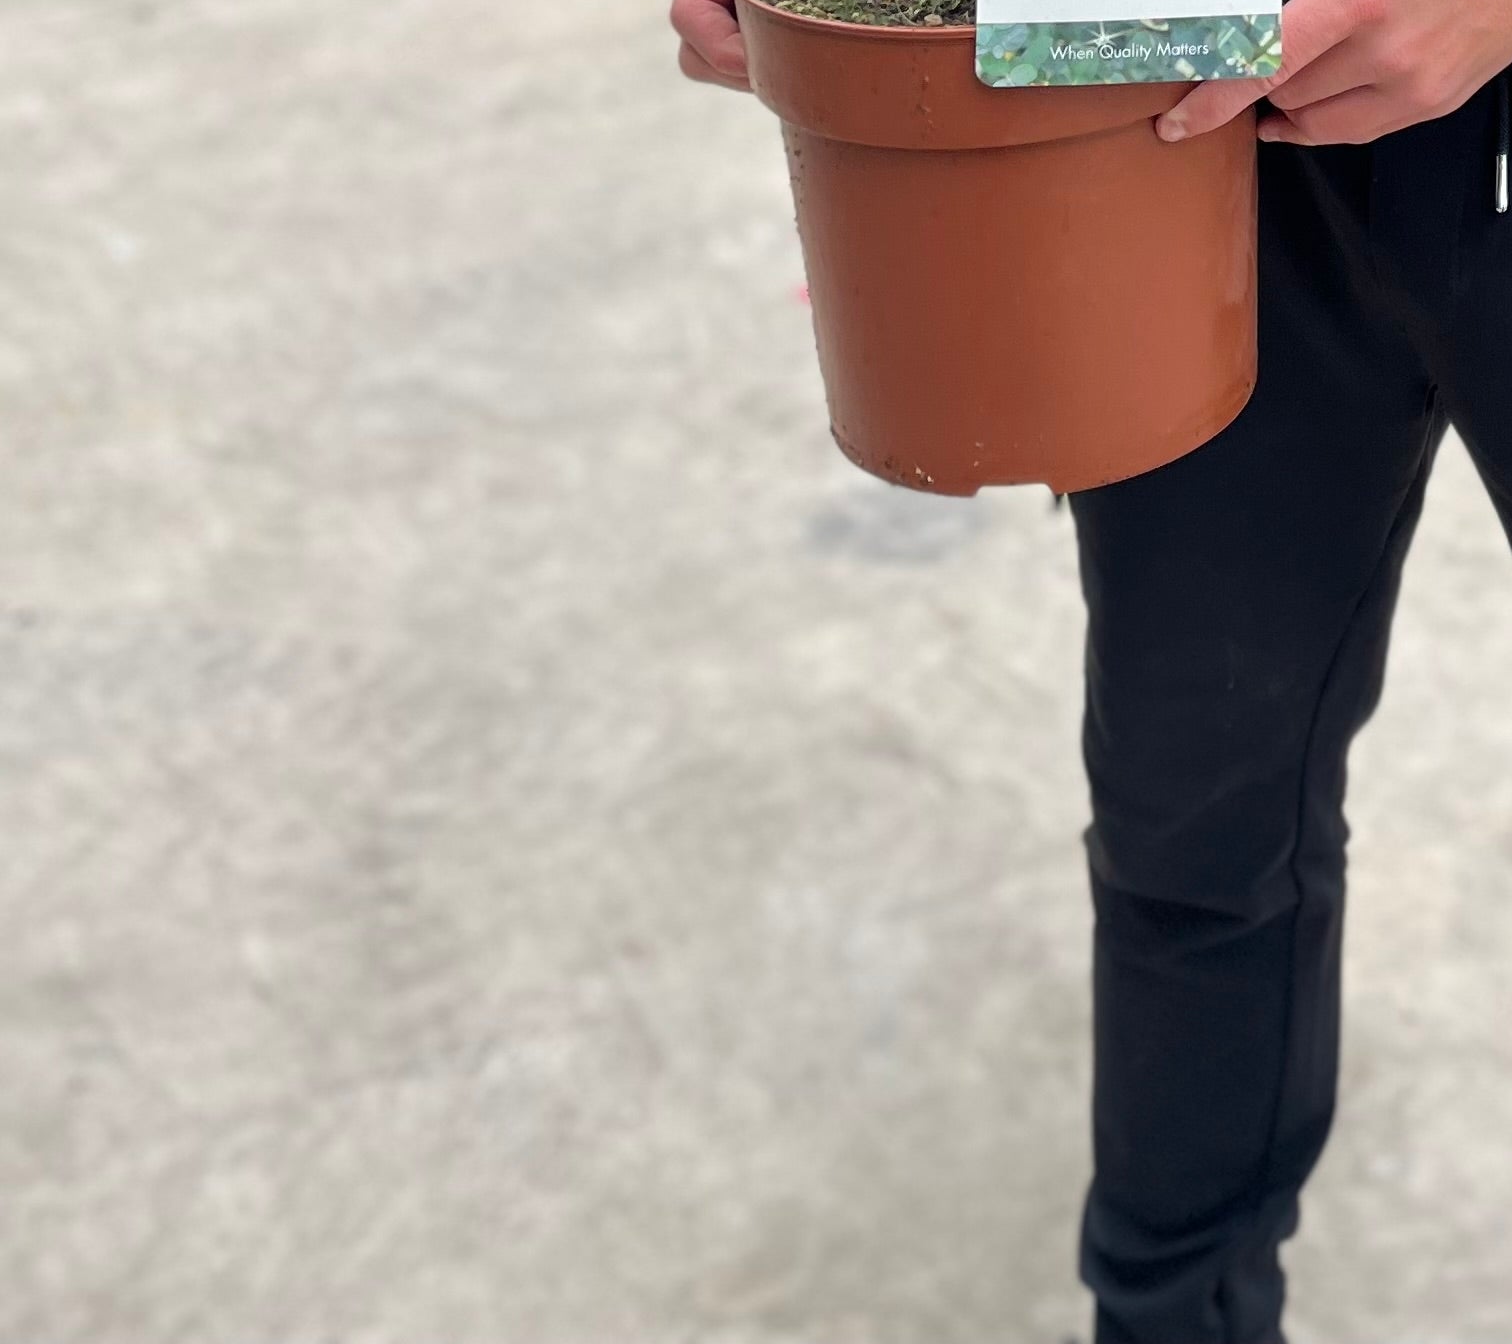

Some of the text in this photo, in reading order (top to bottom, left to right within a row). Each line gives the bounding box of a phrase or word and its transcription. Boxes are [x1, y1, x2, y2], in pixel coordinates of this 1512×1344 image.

[1050, 41, 1210, 63] When Quality Matters
